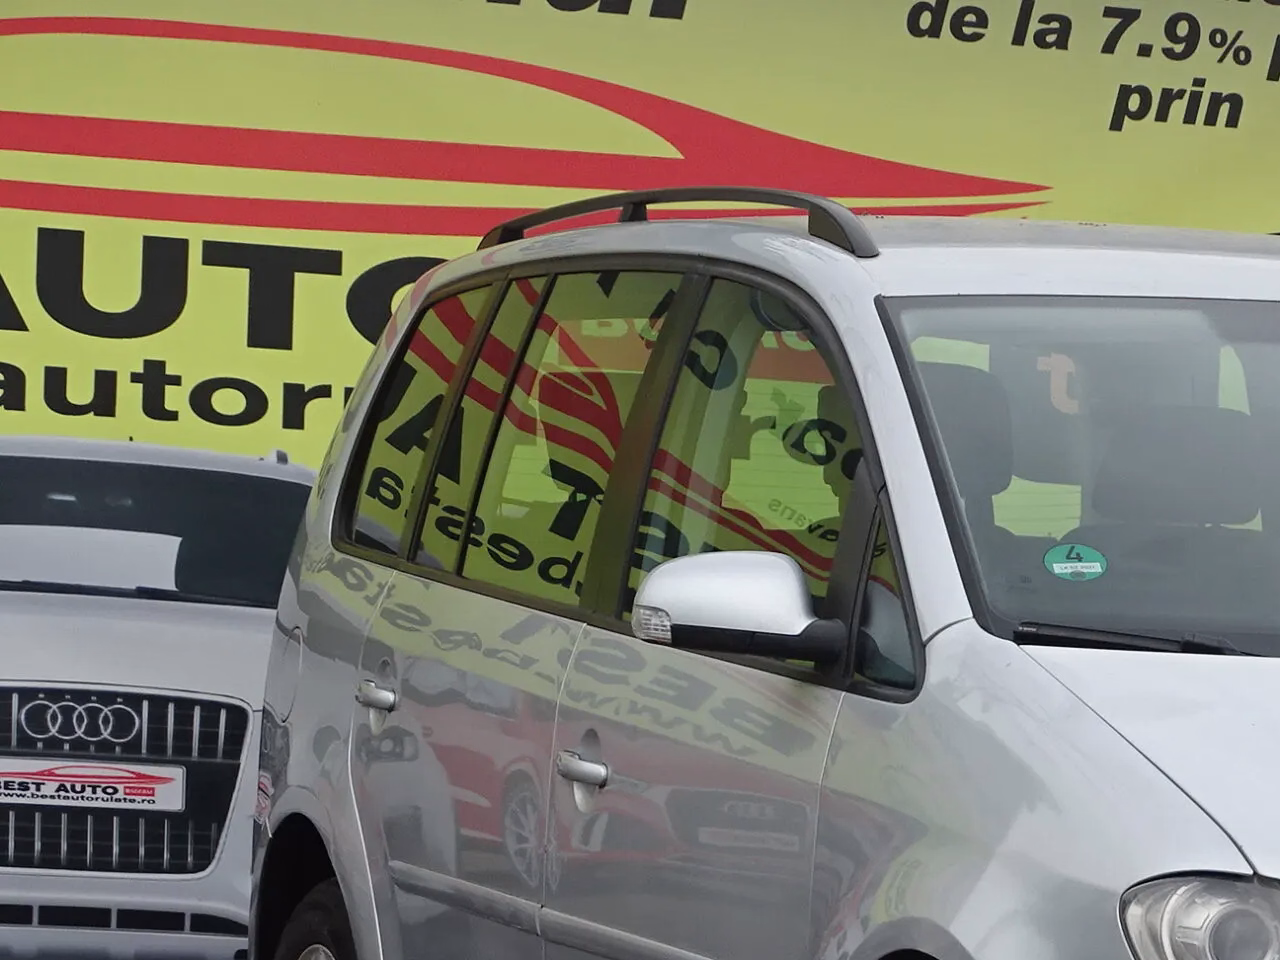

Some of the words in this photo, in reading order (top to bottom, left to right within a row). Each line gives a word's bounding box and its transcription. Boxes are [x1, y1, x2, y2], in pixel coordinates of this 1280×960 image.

[906, 0, 990, 43] de
[1011, 1, 1074, 52] la
[1109, 77, 1245, 132] prin
[0, 780, 46, 792] EST
[55, 783, 119, 796] AUTO
